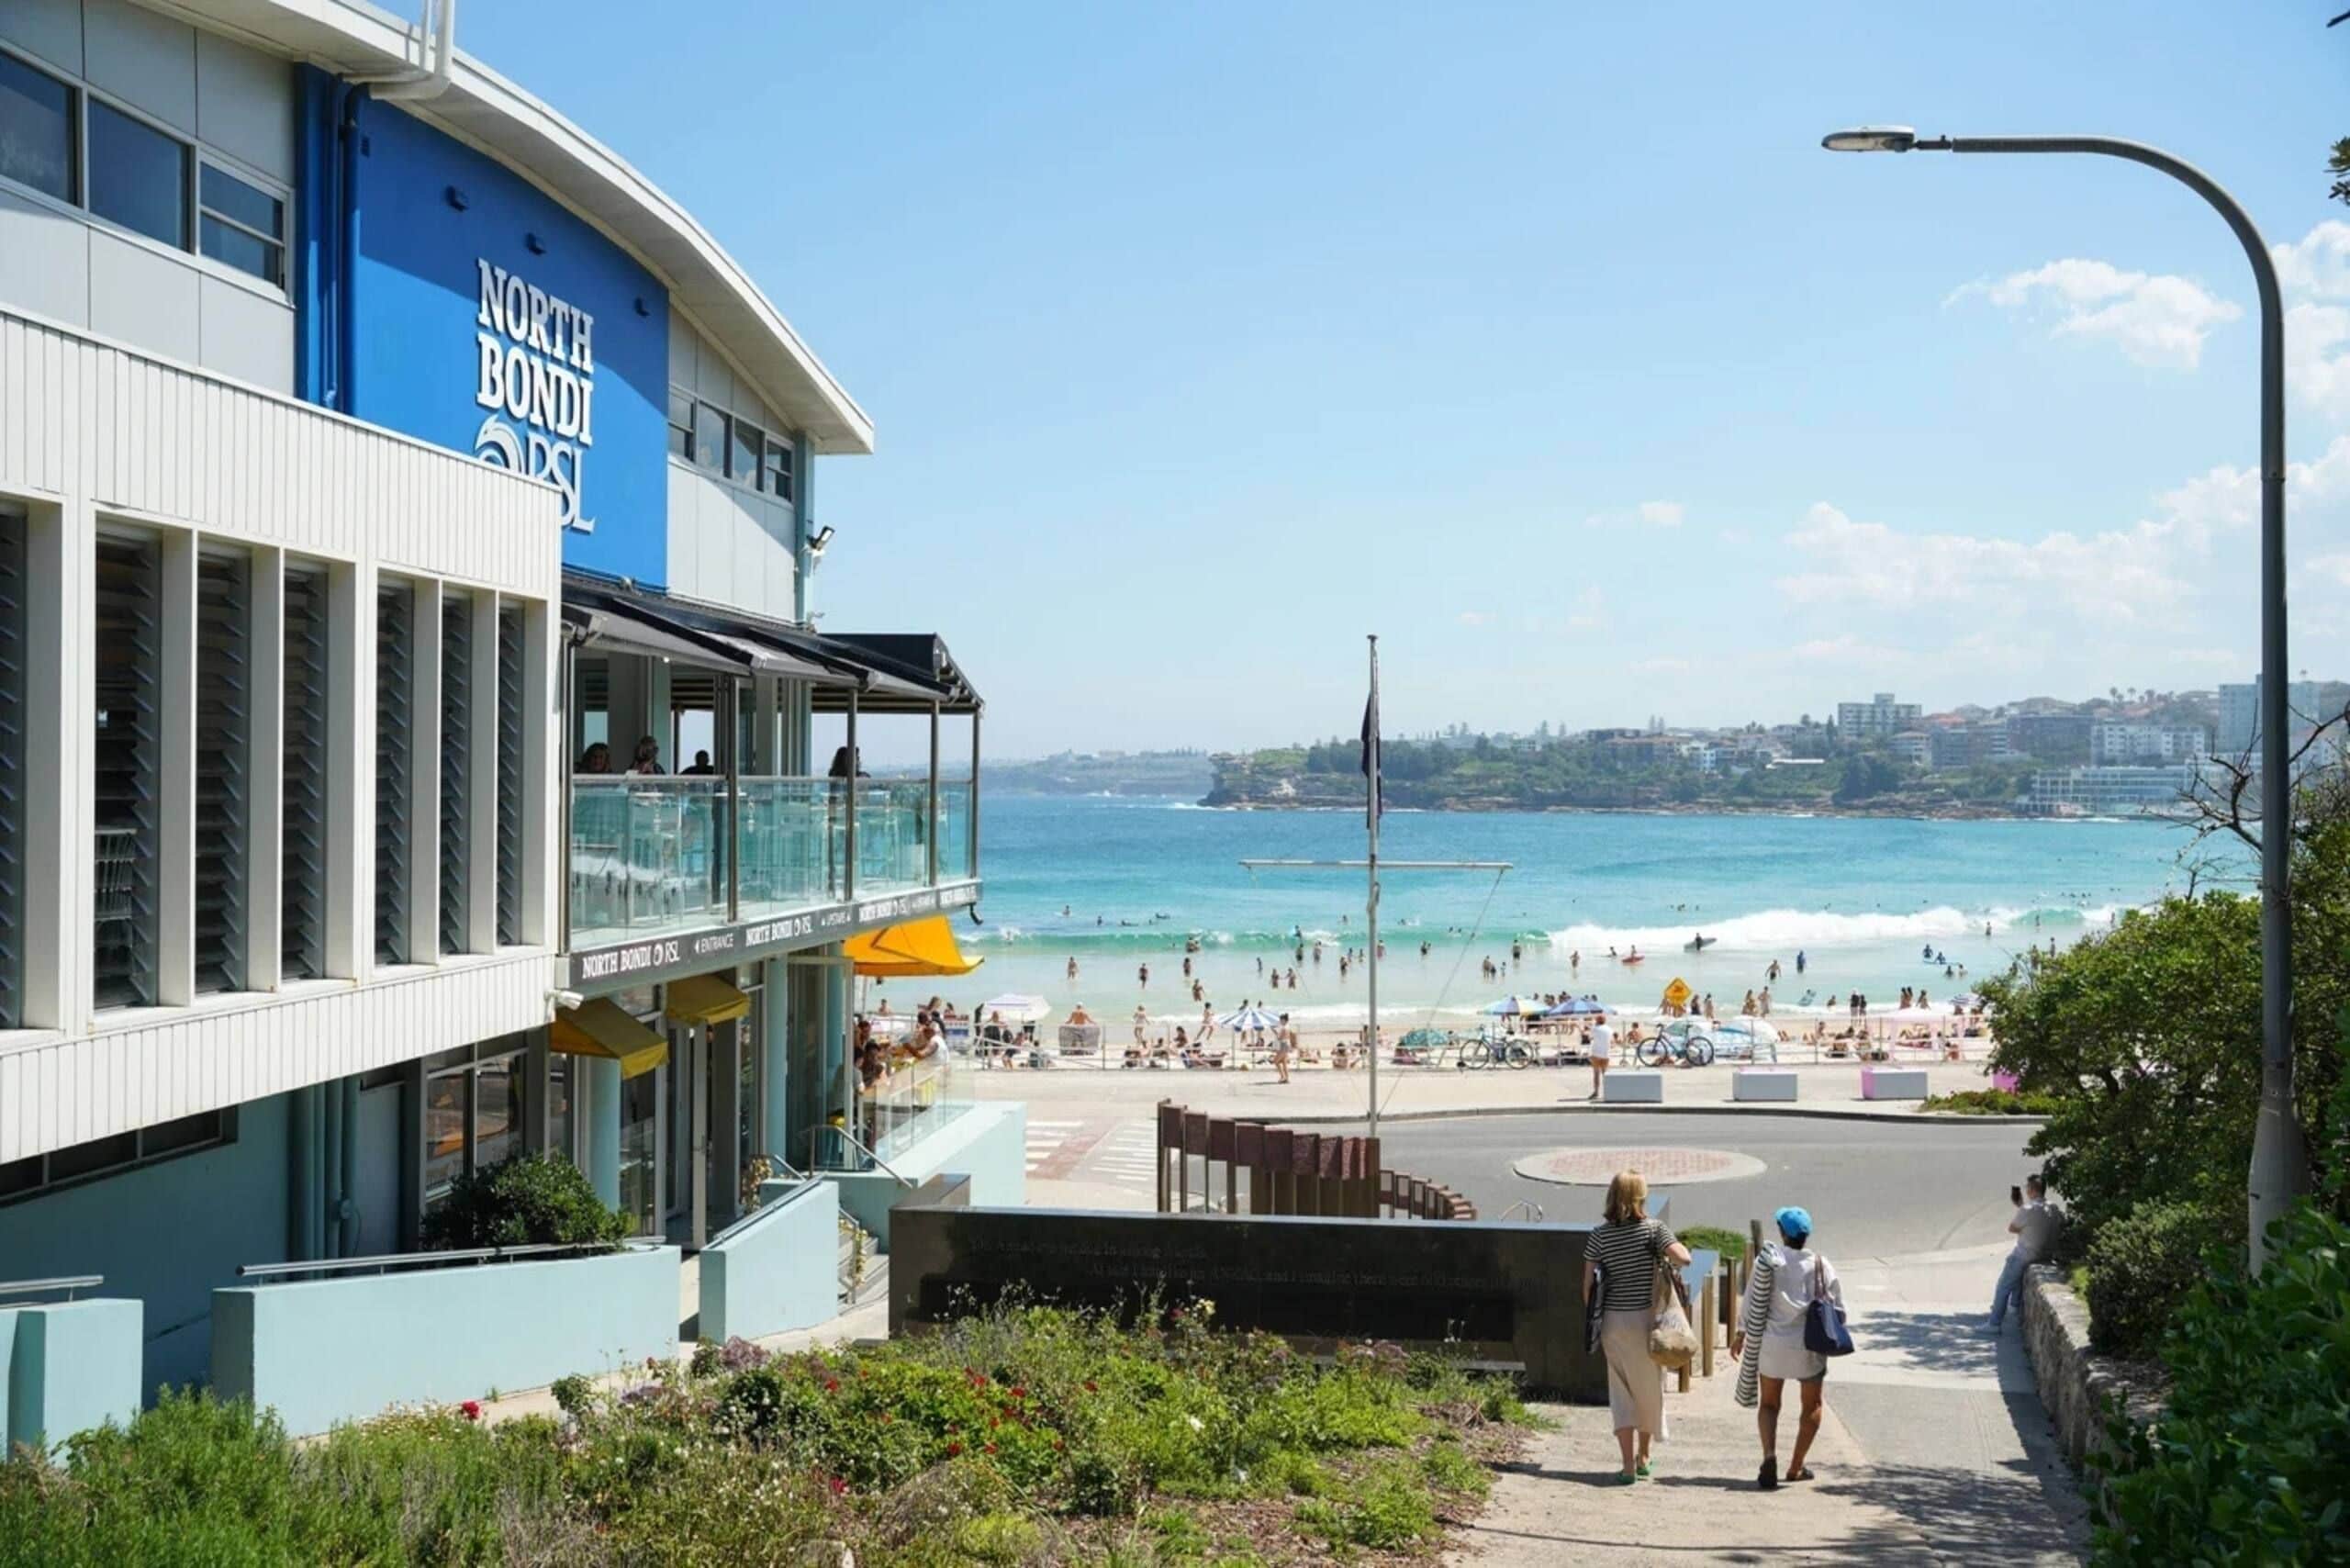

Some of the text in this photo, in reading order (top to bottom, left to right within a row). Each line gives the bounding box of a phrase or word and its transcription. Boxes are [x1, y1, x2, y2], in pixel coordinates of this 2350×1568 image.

[476, 258, 595, 374] NORTH
[476, 331, 595, 446] BONDI
[701, 933, 733, 953] ENTRANCE
[745, 924, 770, 946] NORTH
[771, 919, 793, 940] BONDI
[582, 951, 619, 980] NORTH
[621, 945, 652, 971] BONDI
